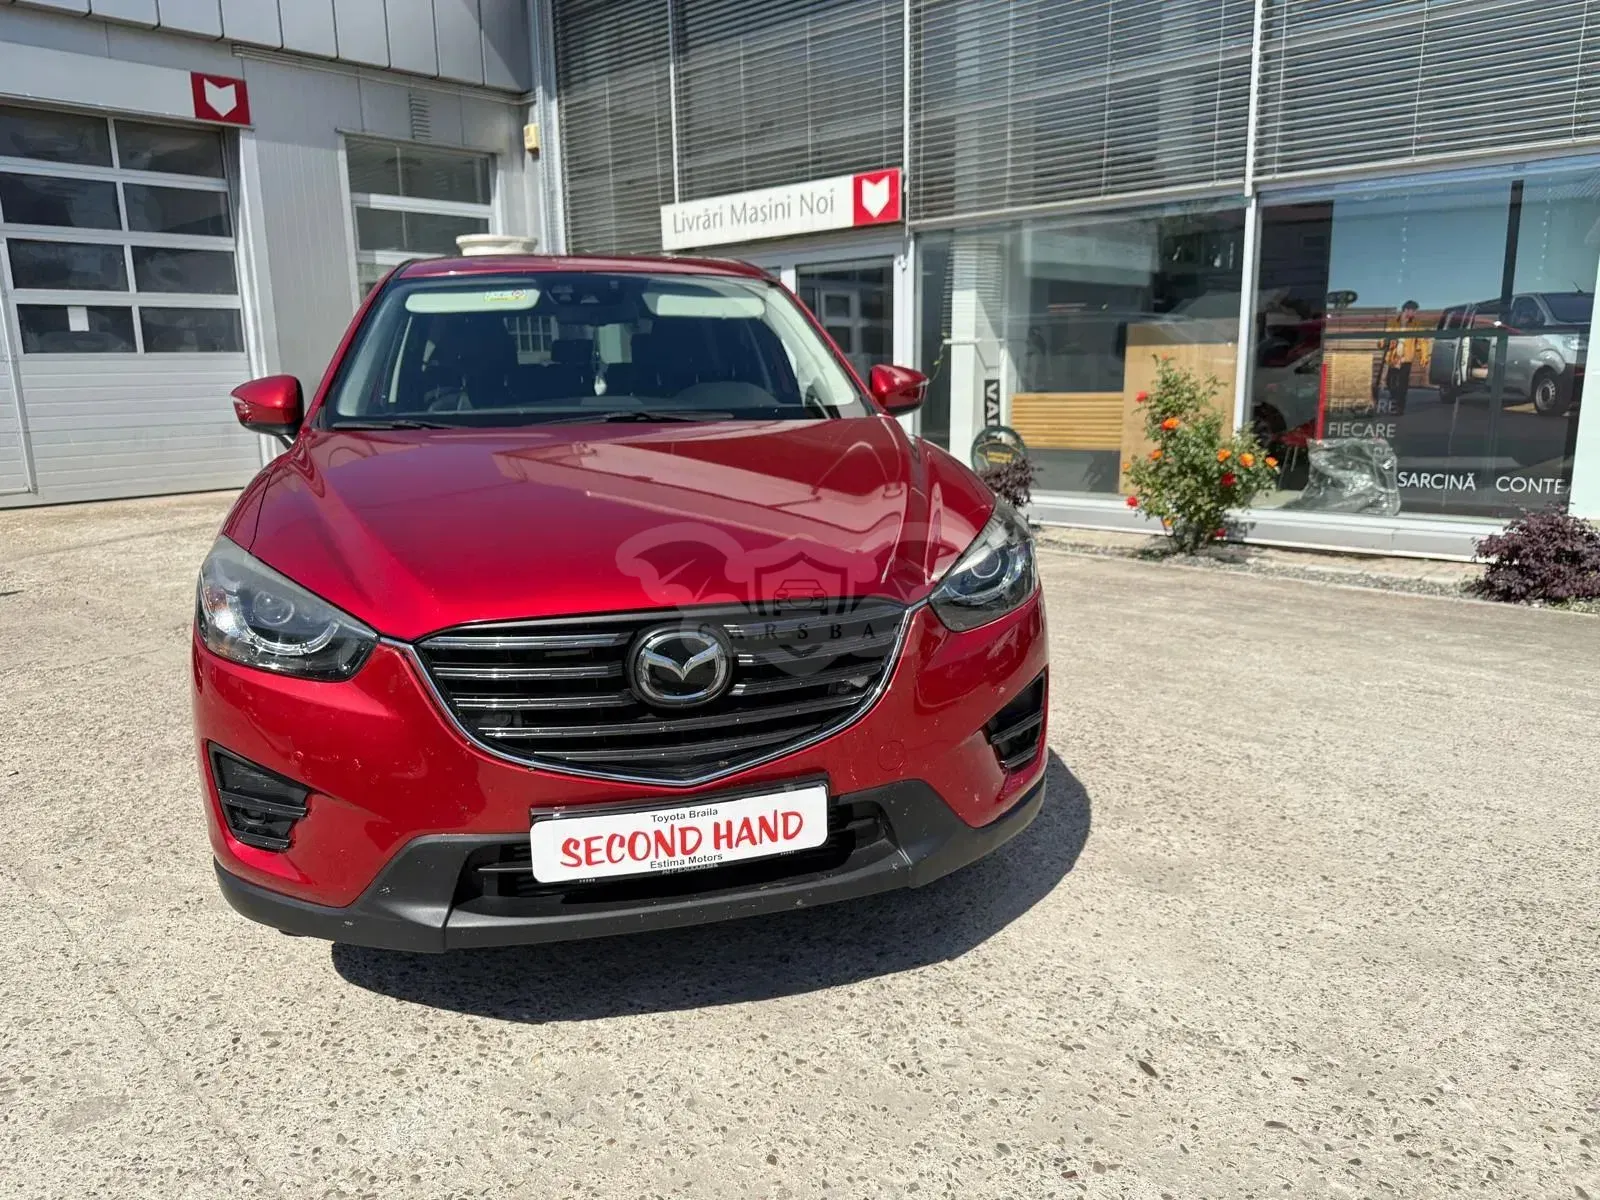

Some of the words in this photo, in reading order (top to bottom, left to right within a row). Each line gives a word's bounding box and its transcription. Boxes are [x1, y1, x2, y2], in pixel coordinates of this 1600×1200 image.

[799, 187, 835, 217] Noi
[1328, 398, 1397, 414] FIECARE
[1327, 422, 1397, 438] FIECARE
[1397, 471, 1477, 491] SARCINĂ
[650, 813, 687, 823] Toyota
[688, 807, 719, 818] Braila
[560, 823, 703, 868] SECOND
[713, 809, 804, 850] HAND
[649, 859, 686, 869] Estima
[688, 853, 723, 864] Motors
